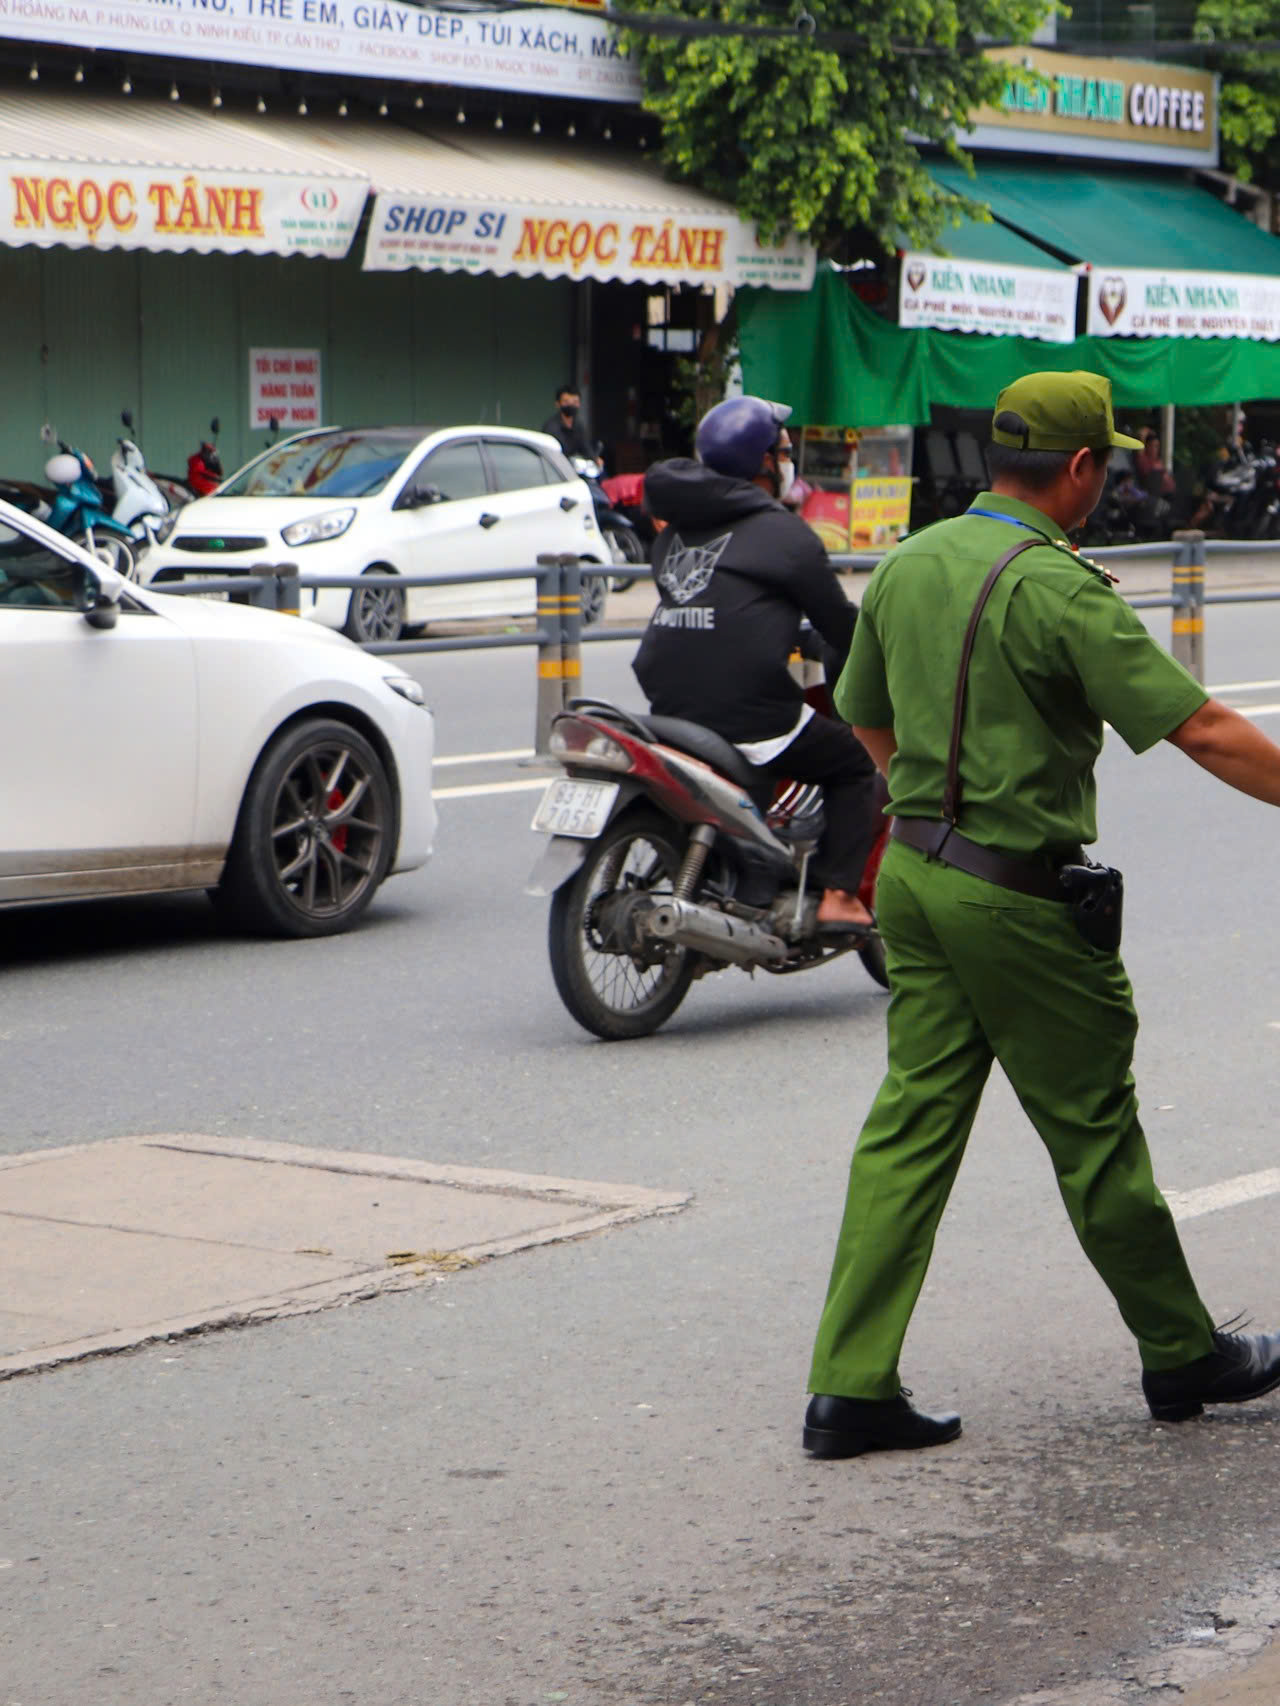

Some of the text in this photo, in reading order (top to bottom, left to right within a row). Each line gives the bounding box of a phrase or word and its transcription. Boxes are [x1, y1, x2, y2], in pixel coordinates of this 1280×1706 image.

[303, 1, 345, 28] EM,
[1055, 75, 1125, 122] NHANH
[1130, 83, 1205, 131] COFFEE
[12, 176, 138, 244] NGỌC
[149, 174, 264, 238] TÁNH
[384, 205, 467, 236] SHOP
[512, 216, 621, 273] NGỌC
[630, 217, 728, 272] TÁNH
[257, 406, 288, 421] SHOP
